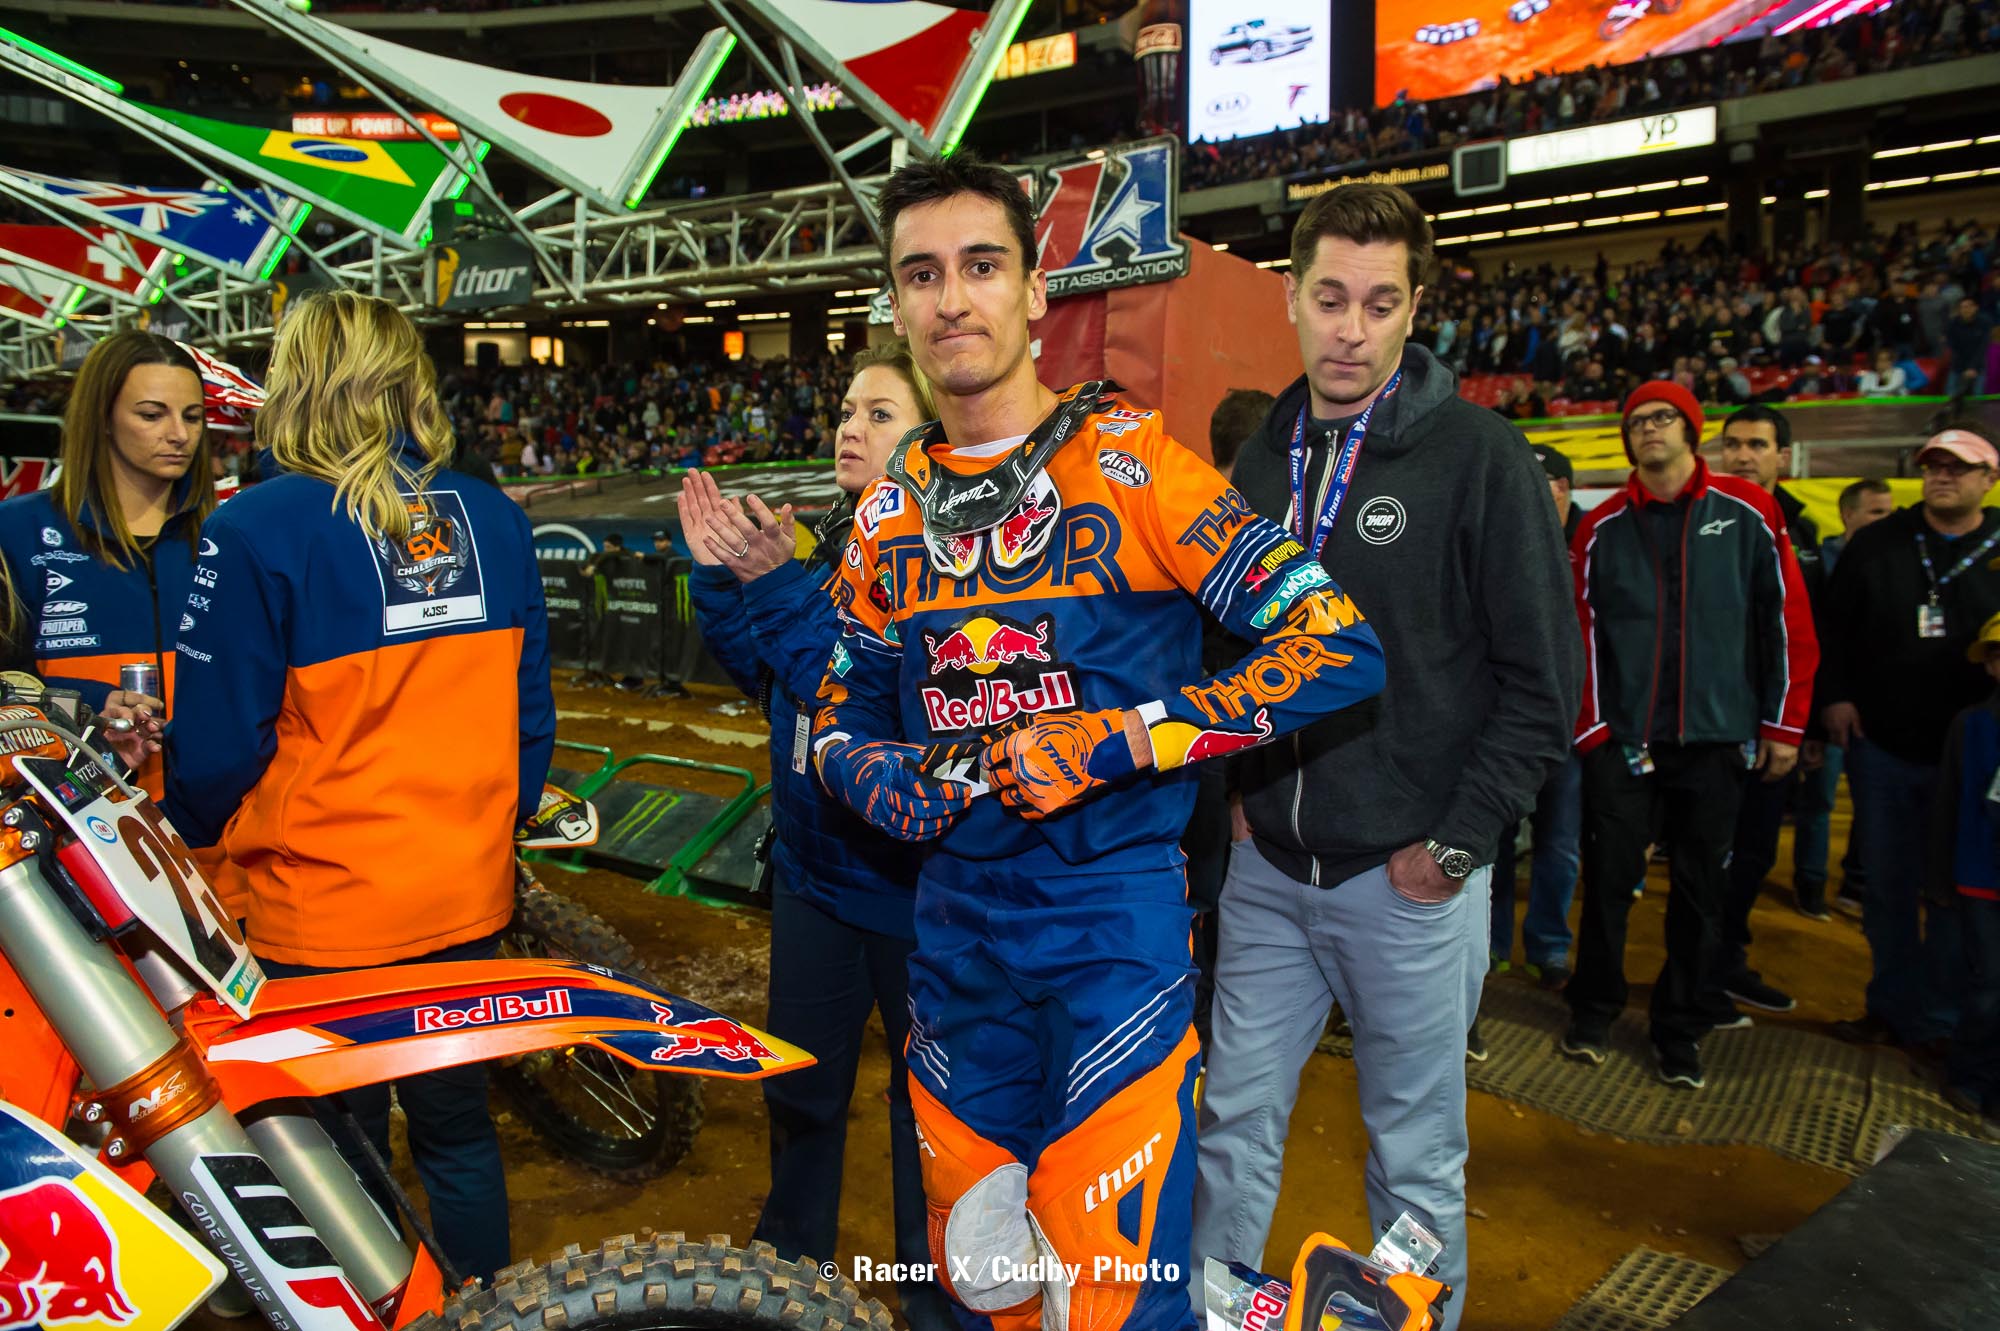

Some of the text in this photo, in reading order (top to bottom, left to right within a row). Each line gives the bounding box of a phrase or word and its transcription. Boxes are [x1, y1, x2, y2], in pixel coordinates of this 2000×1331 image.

[1640, 113, 1678, 143] yp
[453, 265, 528, 298] thor
[1069, 258, 1184, 288] ASSOCIATION
[1099, 452, 1145, 484] Airoh
[1328, 489, 1342, 520] thor
[1176, 487, 1251, 557] THO
[407, 526, 450, 561] SX
[397, 555, 457, 576] CHALLENGE
[41, 620, 83, 633] PROTAPER
[422, 605, 448, 618] KJSC
[45, 636, 97, 649] MOTOREX
[1180, 635, 1354, 725] THOR
[922, 670, 1076, 732] Red Bull
[0, 727, 55, 756] ENTHAL
[1040, 741, 1083, 790] THOR
[414, 989, 573, 1033] Red Bull
[1084, 1131, 1162, 1214] thor
[220, 1243, 272, 1303] VALVE
